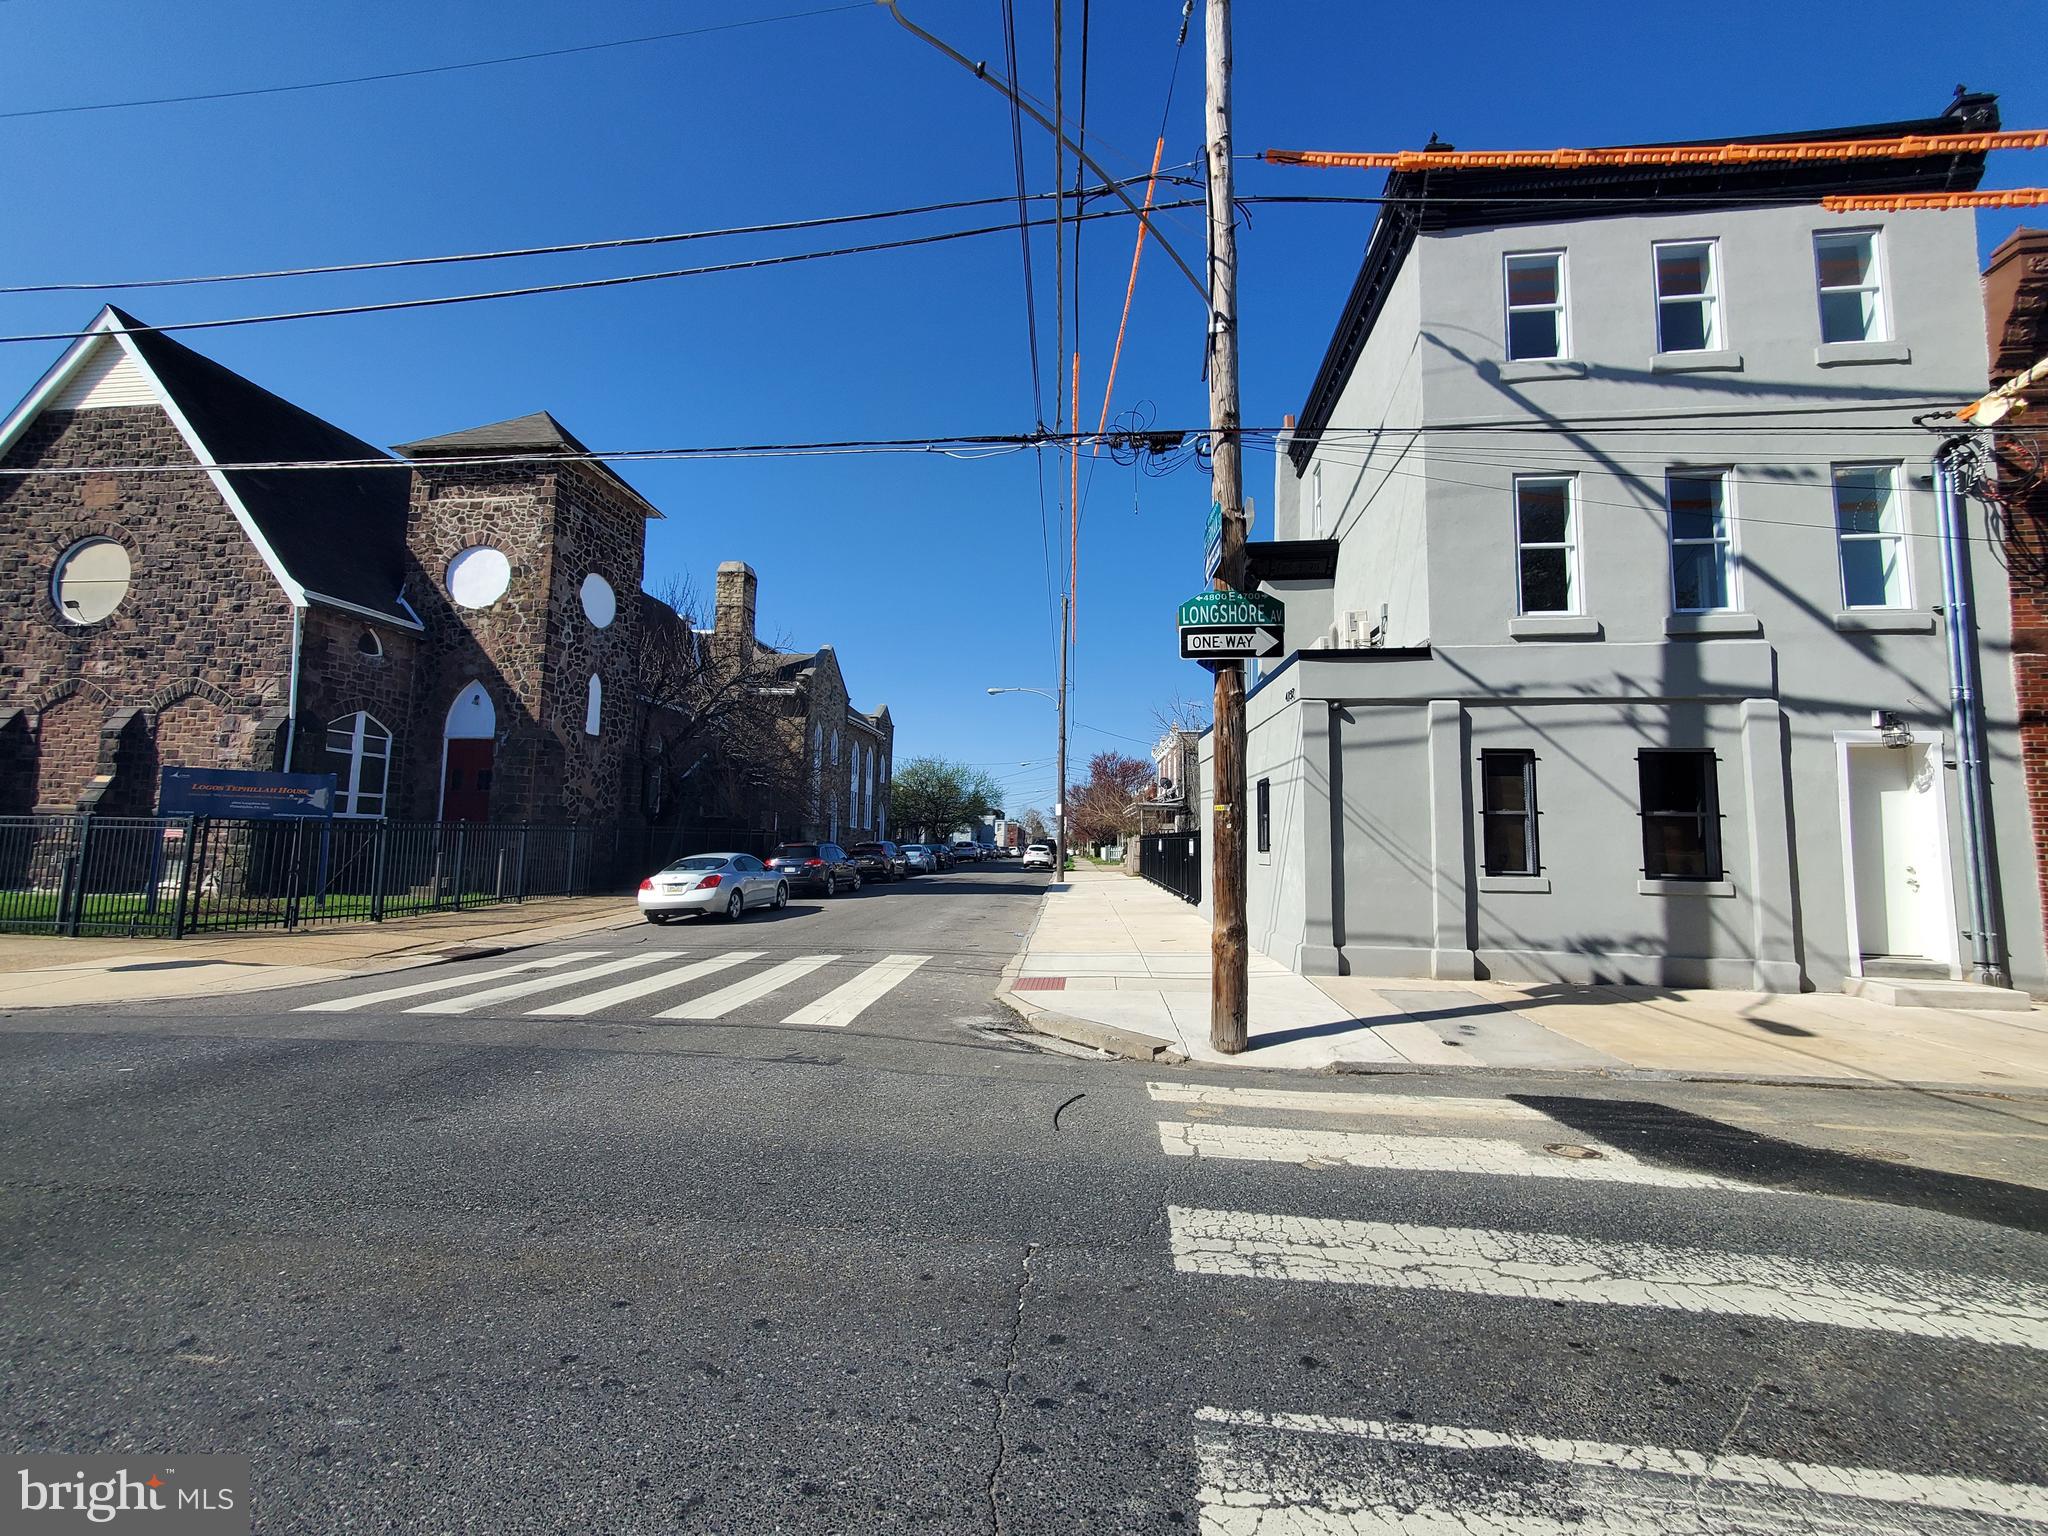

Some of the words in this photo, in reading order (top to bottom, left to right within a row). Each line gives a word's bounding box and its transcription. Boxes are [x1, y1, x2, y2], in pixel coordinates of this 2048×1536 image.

[1203, 593, 1227, 601] 4800
[1228, 592, 1236, 601] E
[1182, 603, 1265, 625] LONGSHORE
[1270, 609, 1282, 622] AV
[1192, 636, 1220, 648] ONE
[1225, 635, 1254, 648] WAY
[191, 783, 225, 791] LOGOS
[225, 785, 278, 793] TEPHILLAH
[278, 787, 309, 795] HOUSE
